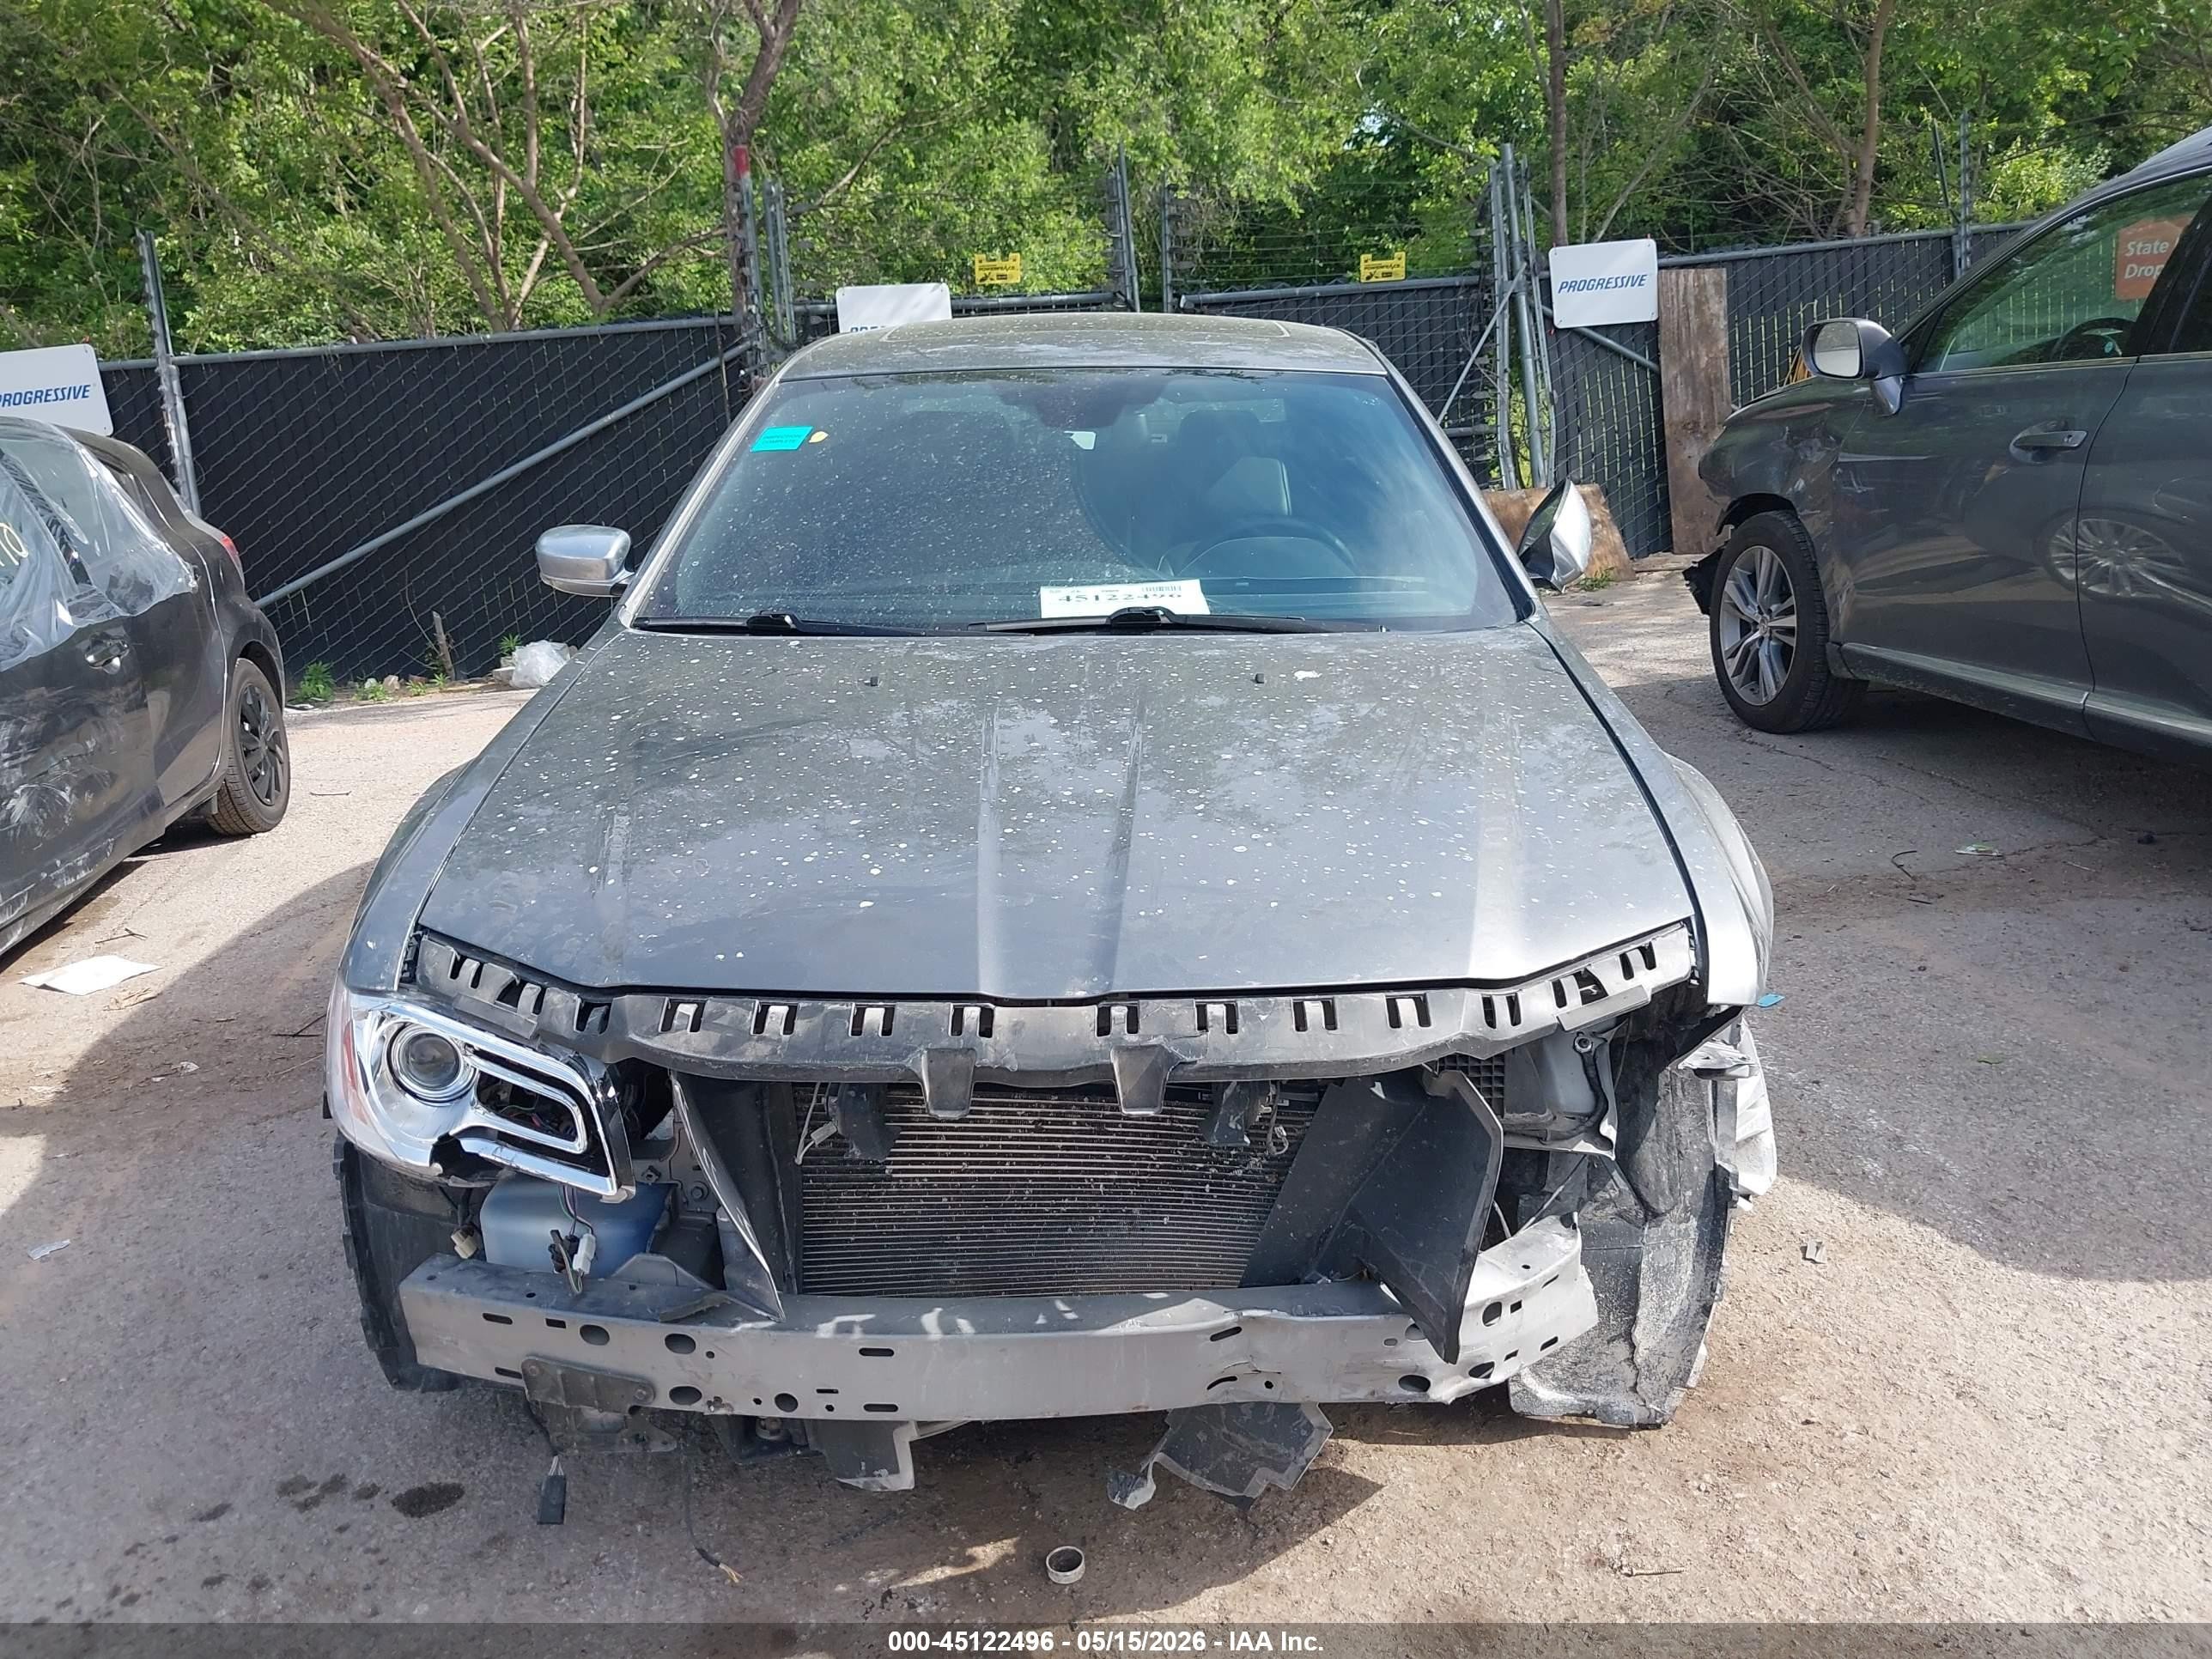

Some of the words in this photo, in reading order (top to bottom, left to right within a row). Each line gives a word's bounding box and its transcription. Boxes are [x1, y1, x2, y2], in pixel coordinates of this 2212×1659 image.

[2124, 240, 2170, 257] State
[2124, 264, 2165, 280] Drop
[1558, 274, 1648, 294] PROGRESSIVE
[1059, 593, 1182, 603] 45122496
